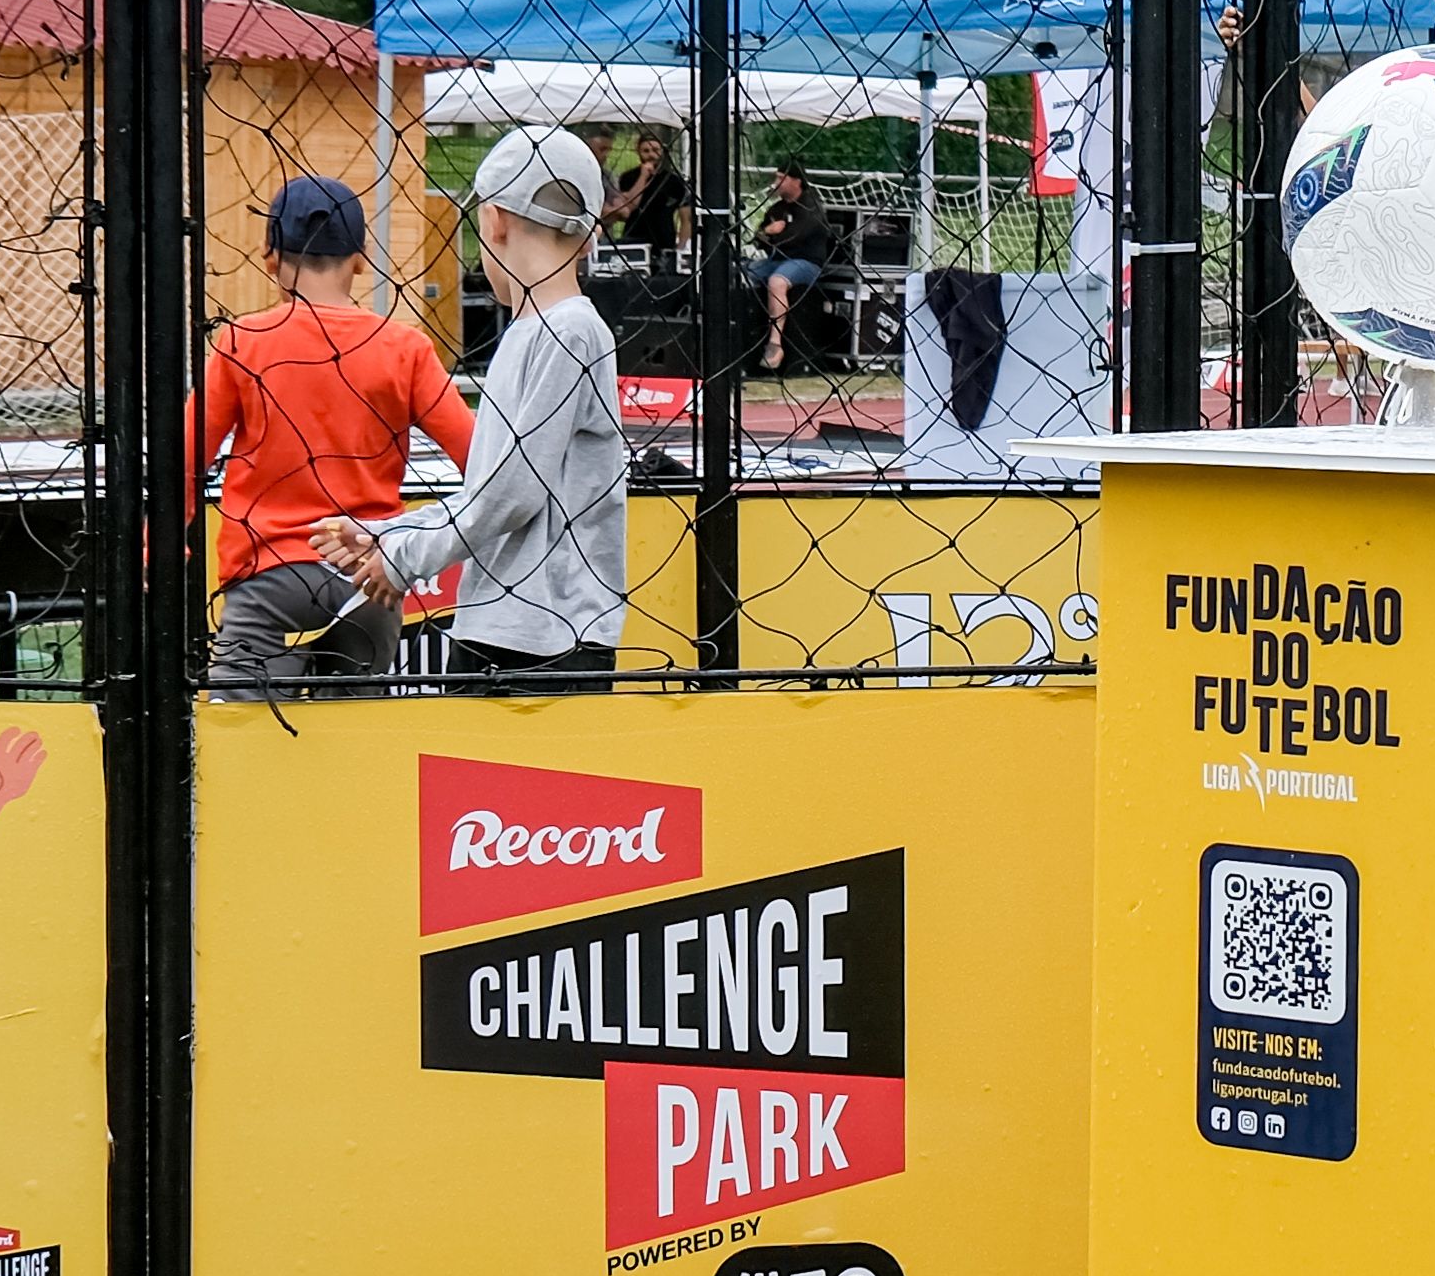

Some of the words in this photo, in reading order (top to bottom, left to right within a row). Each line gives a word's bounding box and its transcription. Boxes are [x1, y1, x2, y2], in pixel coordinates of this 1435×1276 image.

[1166, 563, 1403, 646] FUNDAÇÃO
[1252, 631, 1308, 689] DO
[1194, 675, 1401, 756] FUTEBOL
[1202, 760, 1241, 793] LIGA
[1265, 768, 1358, 803] PORTUGAL
[448, 806, 666, 872] Record
[468, 884, 849, 1060] CHALLENGE
[1212, 1057, 1341, 1089] fundacaodofutebol.
[1213, 1026, 1293, 1057] VISITE-NOS
[1298, 1037, 1323, 1061] EM:
[1212, 1078, 1309, 1107] ligaportugal.pt
[656, 1083, 850, 1219] PARK
[606, 1227, 724, 1276] POWERED
[724, 1216, 763, 1247] BY
